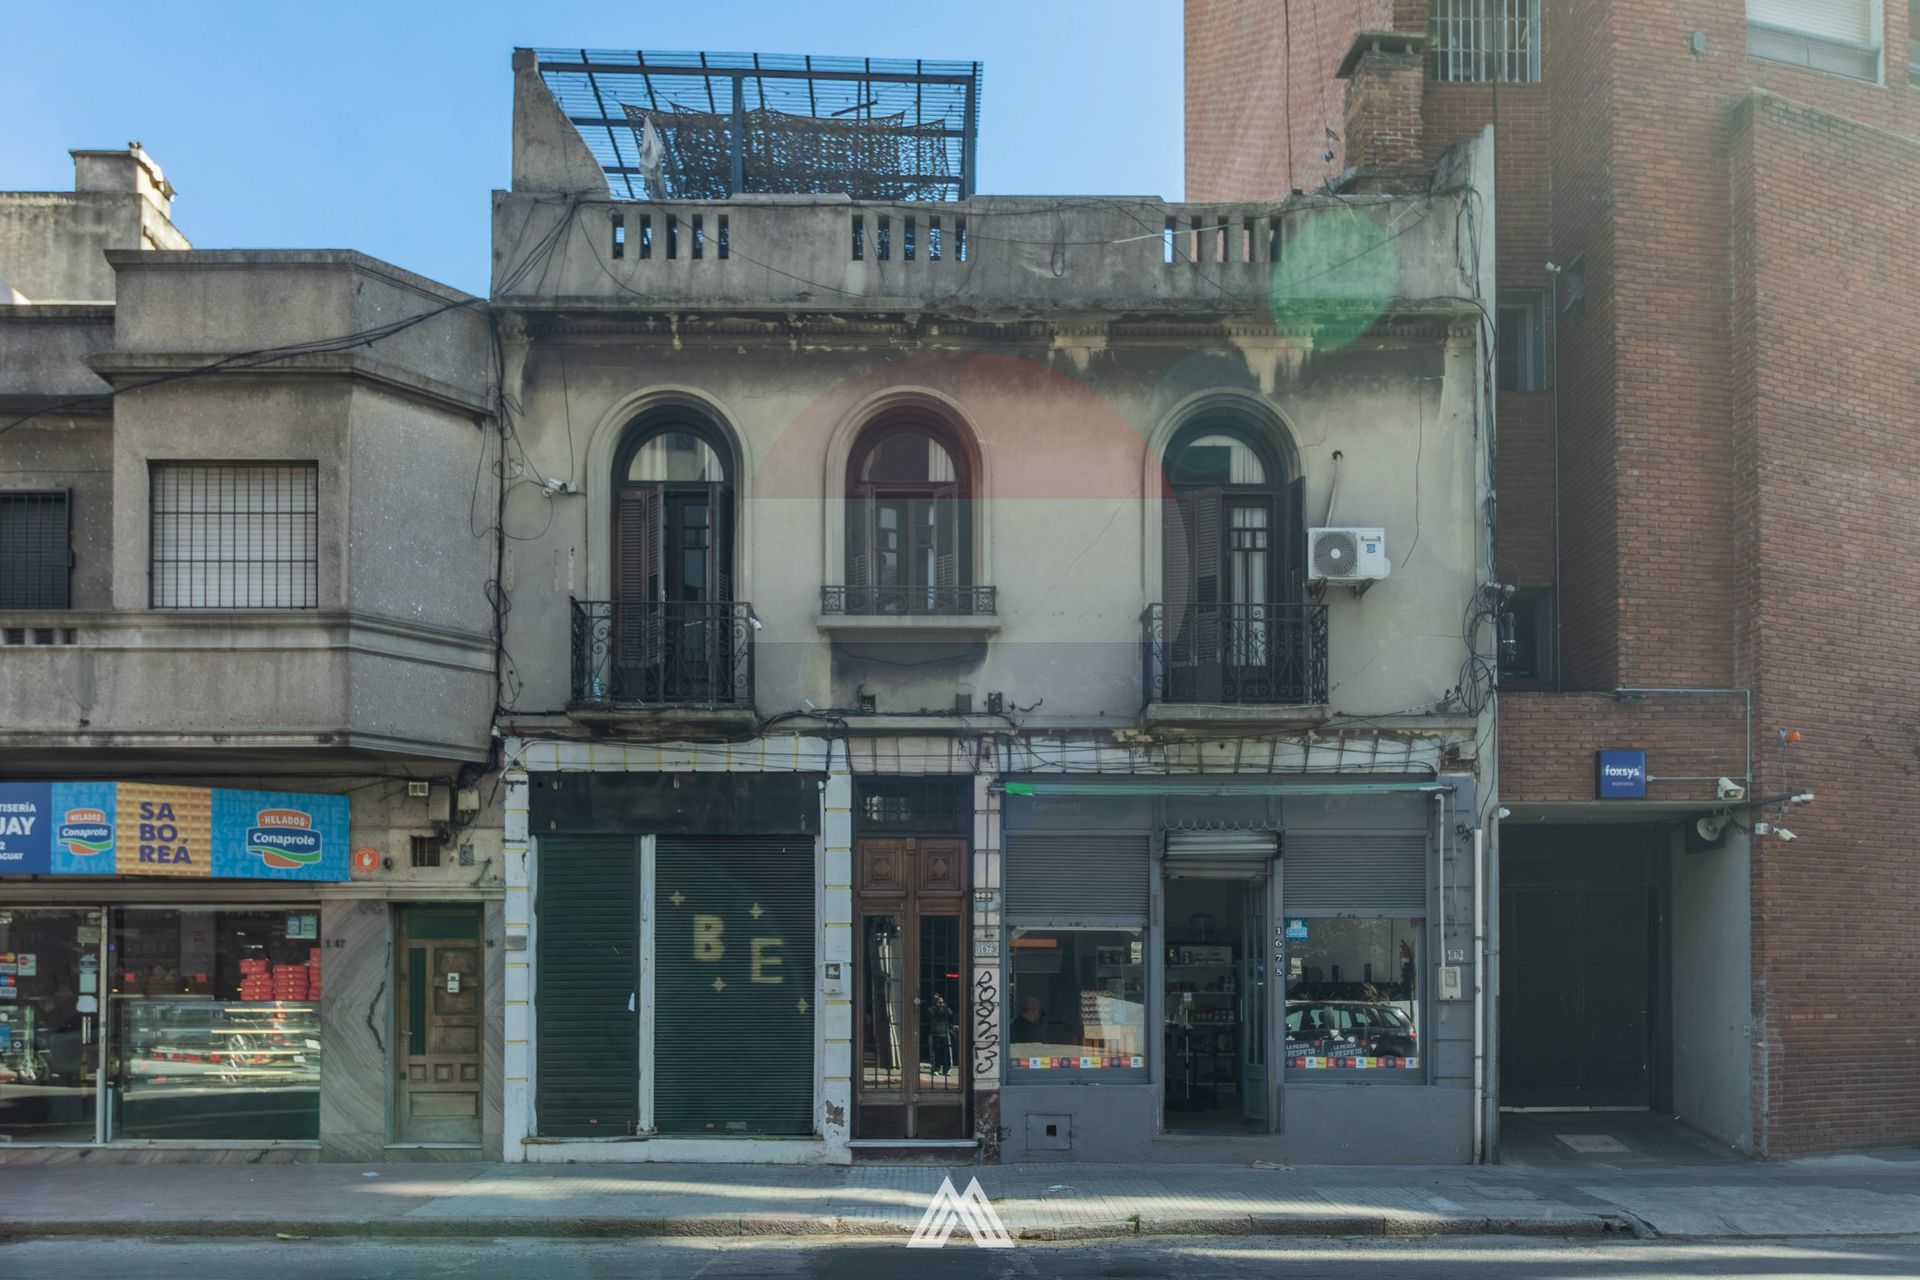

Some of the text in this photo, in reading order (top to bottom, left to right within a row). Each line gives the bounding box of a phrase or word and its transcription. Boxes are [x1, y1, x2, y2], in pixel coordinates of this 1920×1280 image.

[1605, 764, 1640, 780] foxsys
[139, 801, 176, 821] SA
[263, 814, 306, 827] HELADOS
[62, 827, 109, 838] Conaprole
[139, 823, 178, 842] BO
[252, 832, 316, 847] Conaprole
[139, 838, 192, 865] REÁ
[1287, 1048, 1315, 1057] RESPETA
[1335, 1048, 1362, 1057] RESPETA
